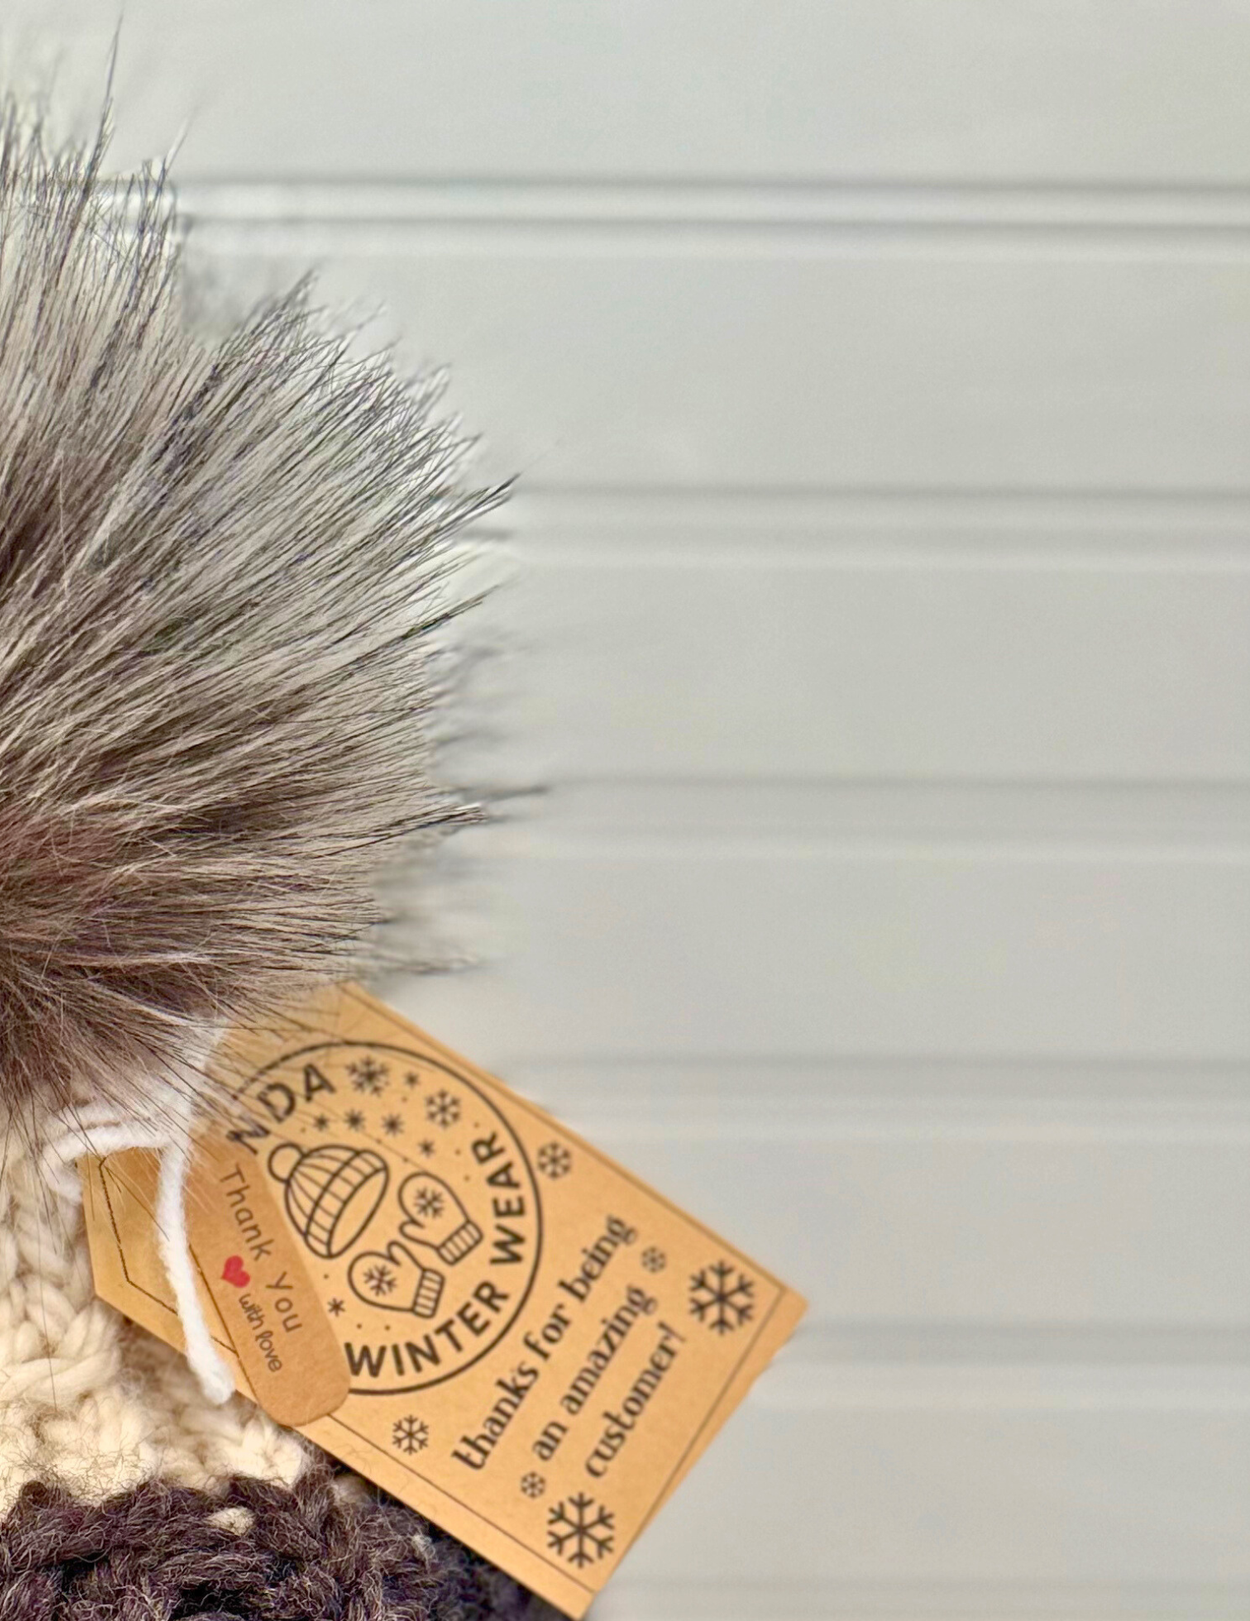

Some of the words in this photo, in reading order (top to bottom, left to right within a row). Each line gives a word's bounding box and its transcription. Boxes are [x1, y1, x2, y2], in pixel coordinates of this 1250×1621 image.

[220, 1163, 274, 1261] Thank
[265, 1271, 302, 1333] You
[238, 1294, 265, 1330] with
[255, 1330, 283, 1372] love
[344, 1280, 511, 1378] WINTER
[471, 1131, 525, 1265] WEAR
[451, 1361, 539, 1471] thanks
[523, 1302, 571, 1362] for
[557, 1214, 638, 1303] being
[532, 1420, 569, 1461] an
[559, 1283, 658, 1415] amazing
[585, 1320, 686, 1479] customer!
